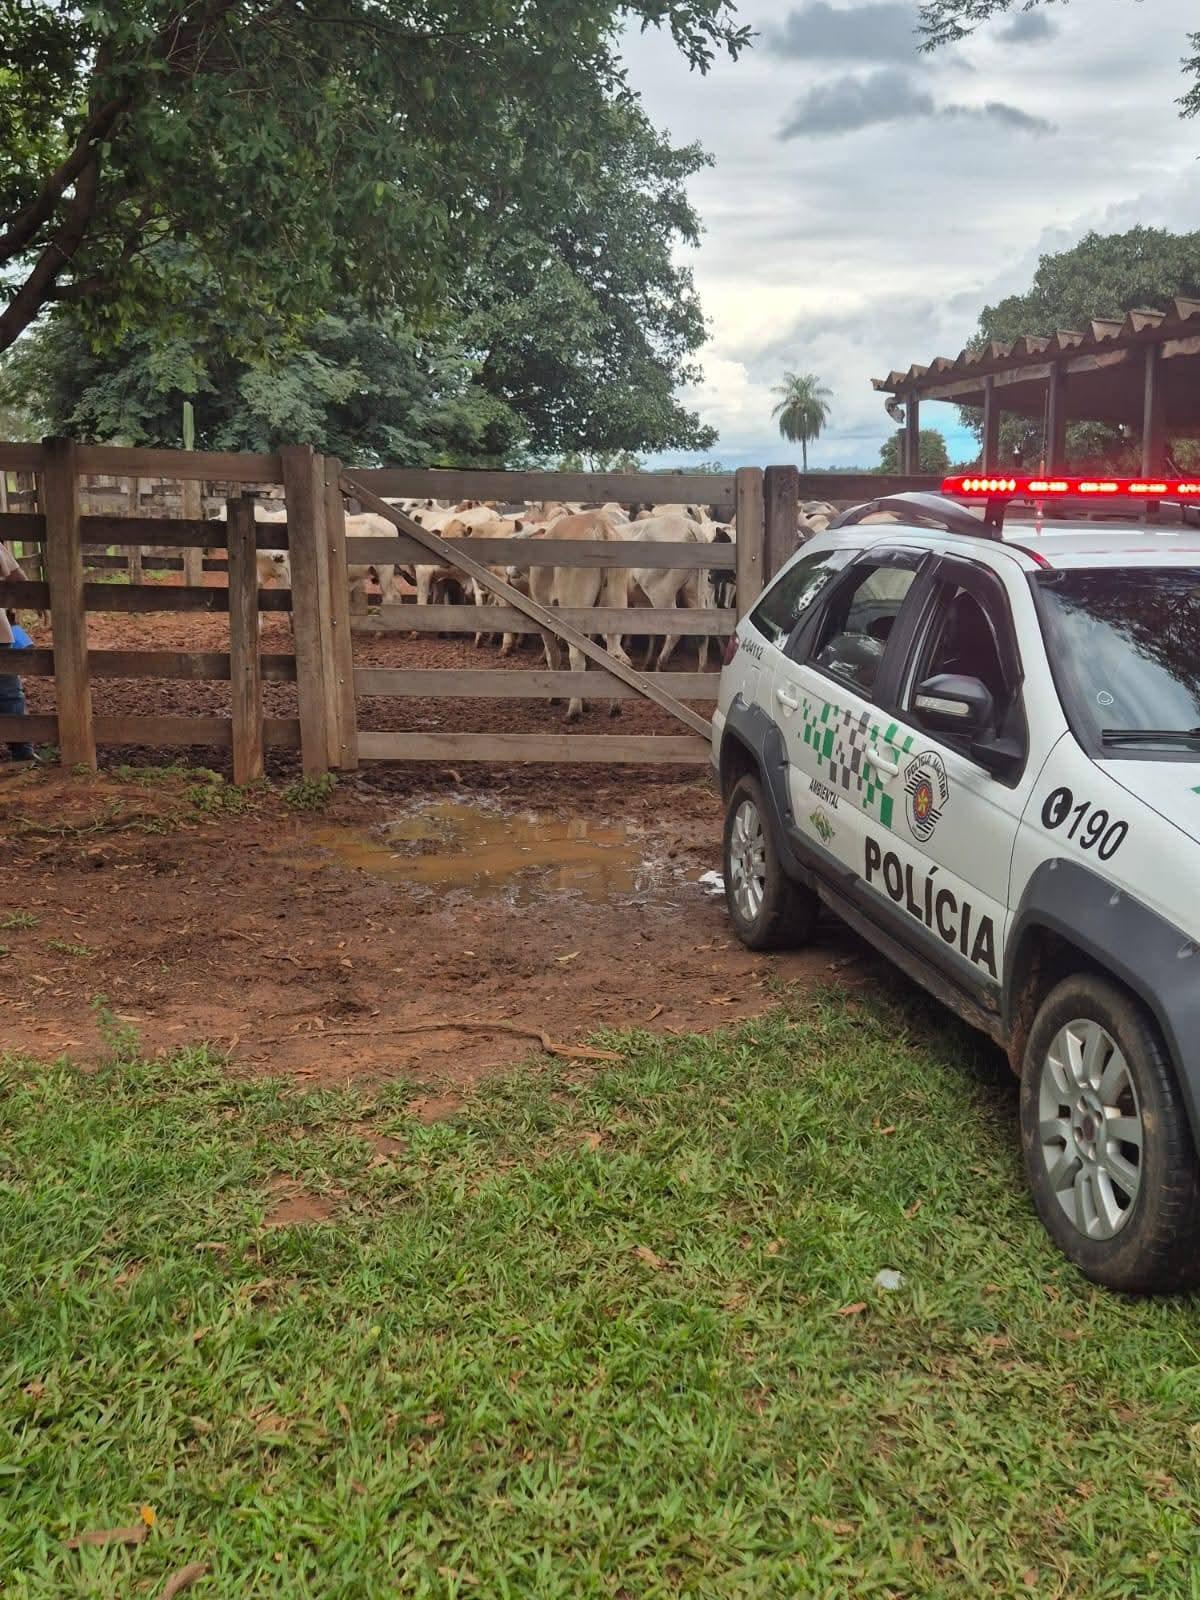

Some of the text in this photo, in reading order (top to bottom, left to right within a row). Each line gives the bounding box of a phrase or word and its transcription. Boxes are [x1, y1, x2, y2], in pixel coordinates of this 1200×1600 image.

[809, 778, 839, 809] AMBIENTAL
[1067, 801, 1129, 861] 190
[865, 836, 998, 980] POLÍCIA
